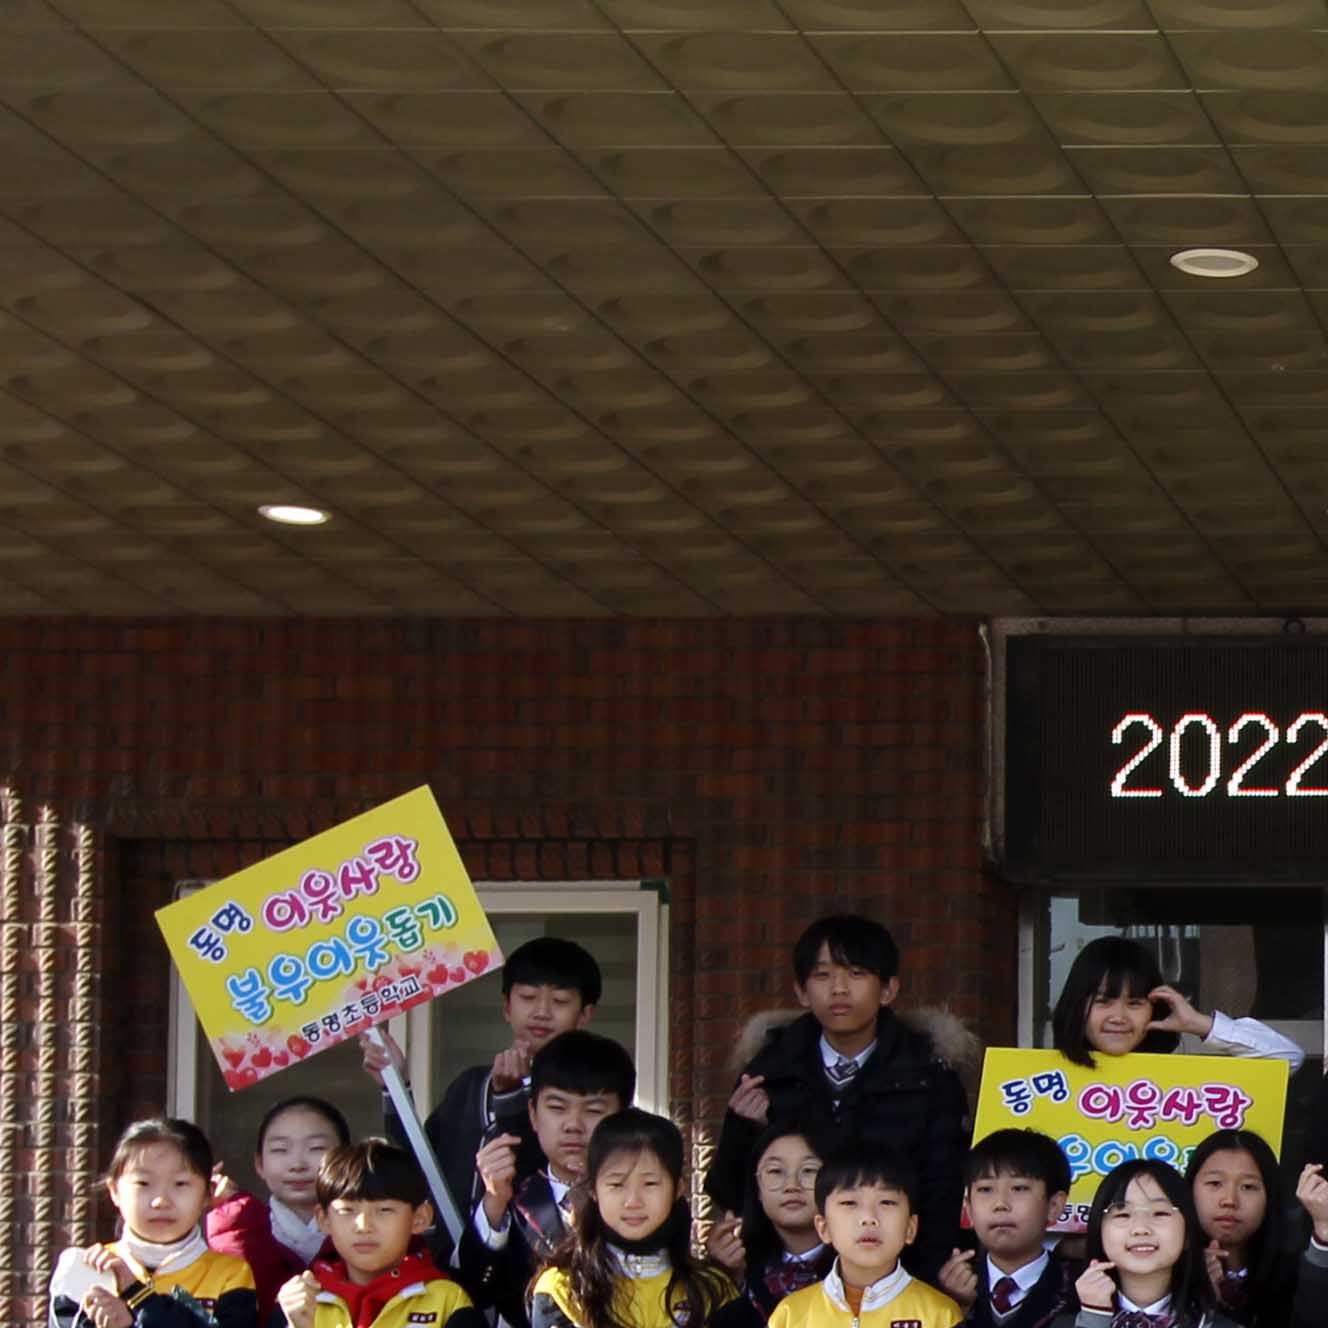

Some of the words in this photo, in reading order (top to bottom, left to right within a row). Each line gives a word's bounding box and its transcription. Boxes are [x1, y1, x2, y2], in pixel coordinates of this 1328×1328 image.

[190, 904, 250, 961] 동명
[264, 836, 418, 931] 이웃사랑
[227, 896, 457, 1025] 불우이웃돕기
[302, 975, 421, 1041] 동명초등학교
[1001, 1071, 1068, 1114] 동명
[1079, 1080, 1251, 1129] 이웃사랑
